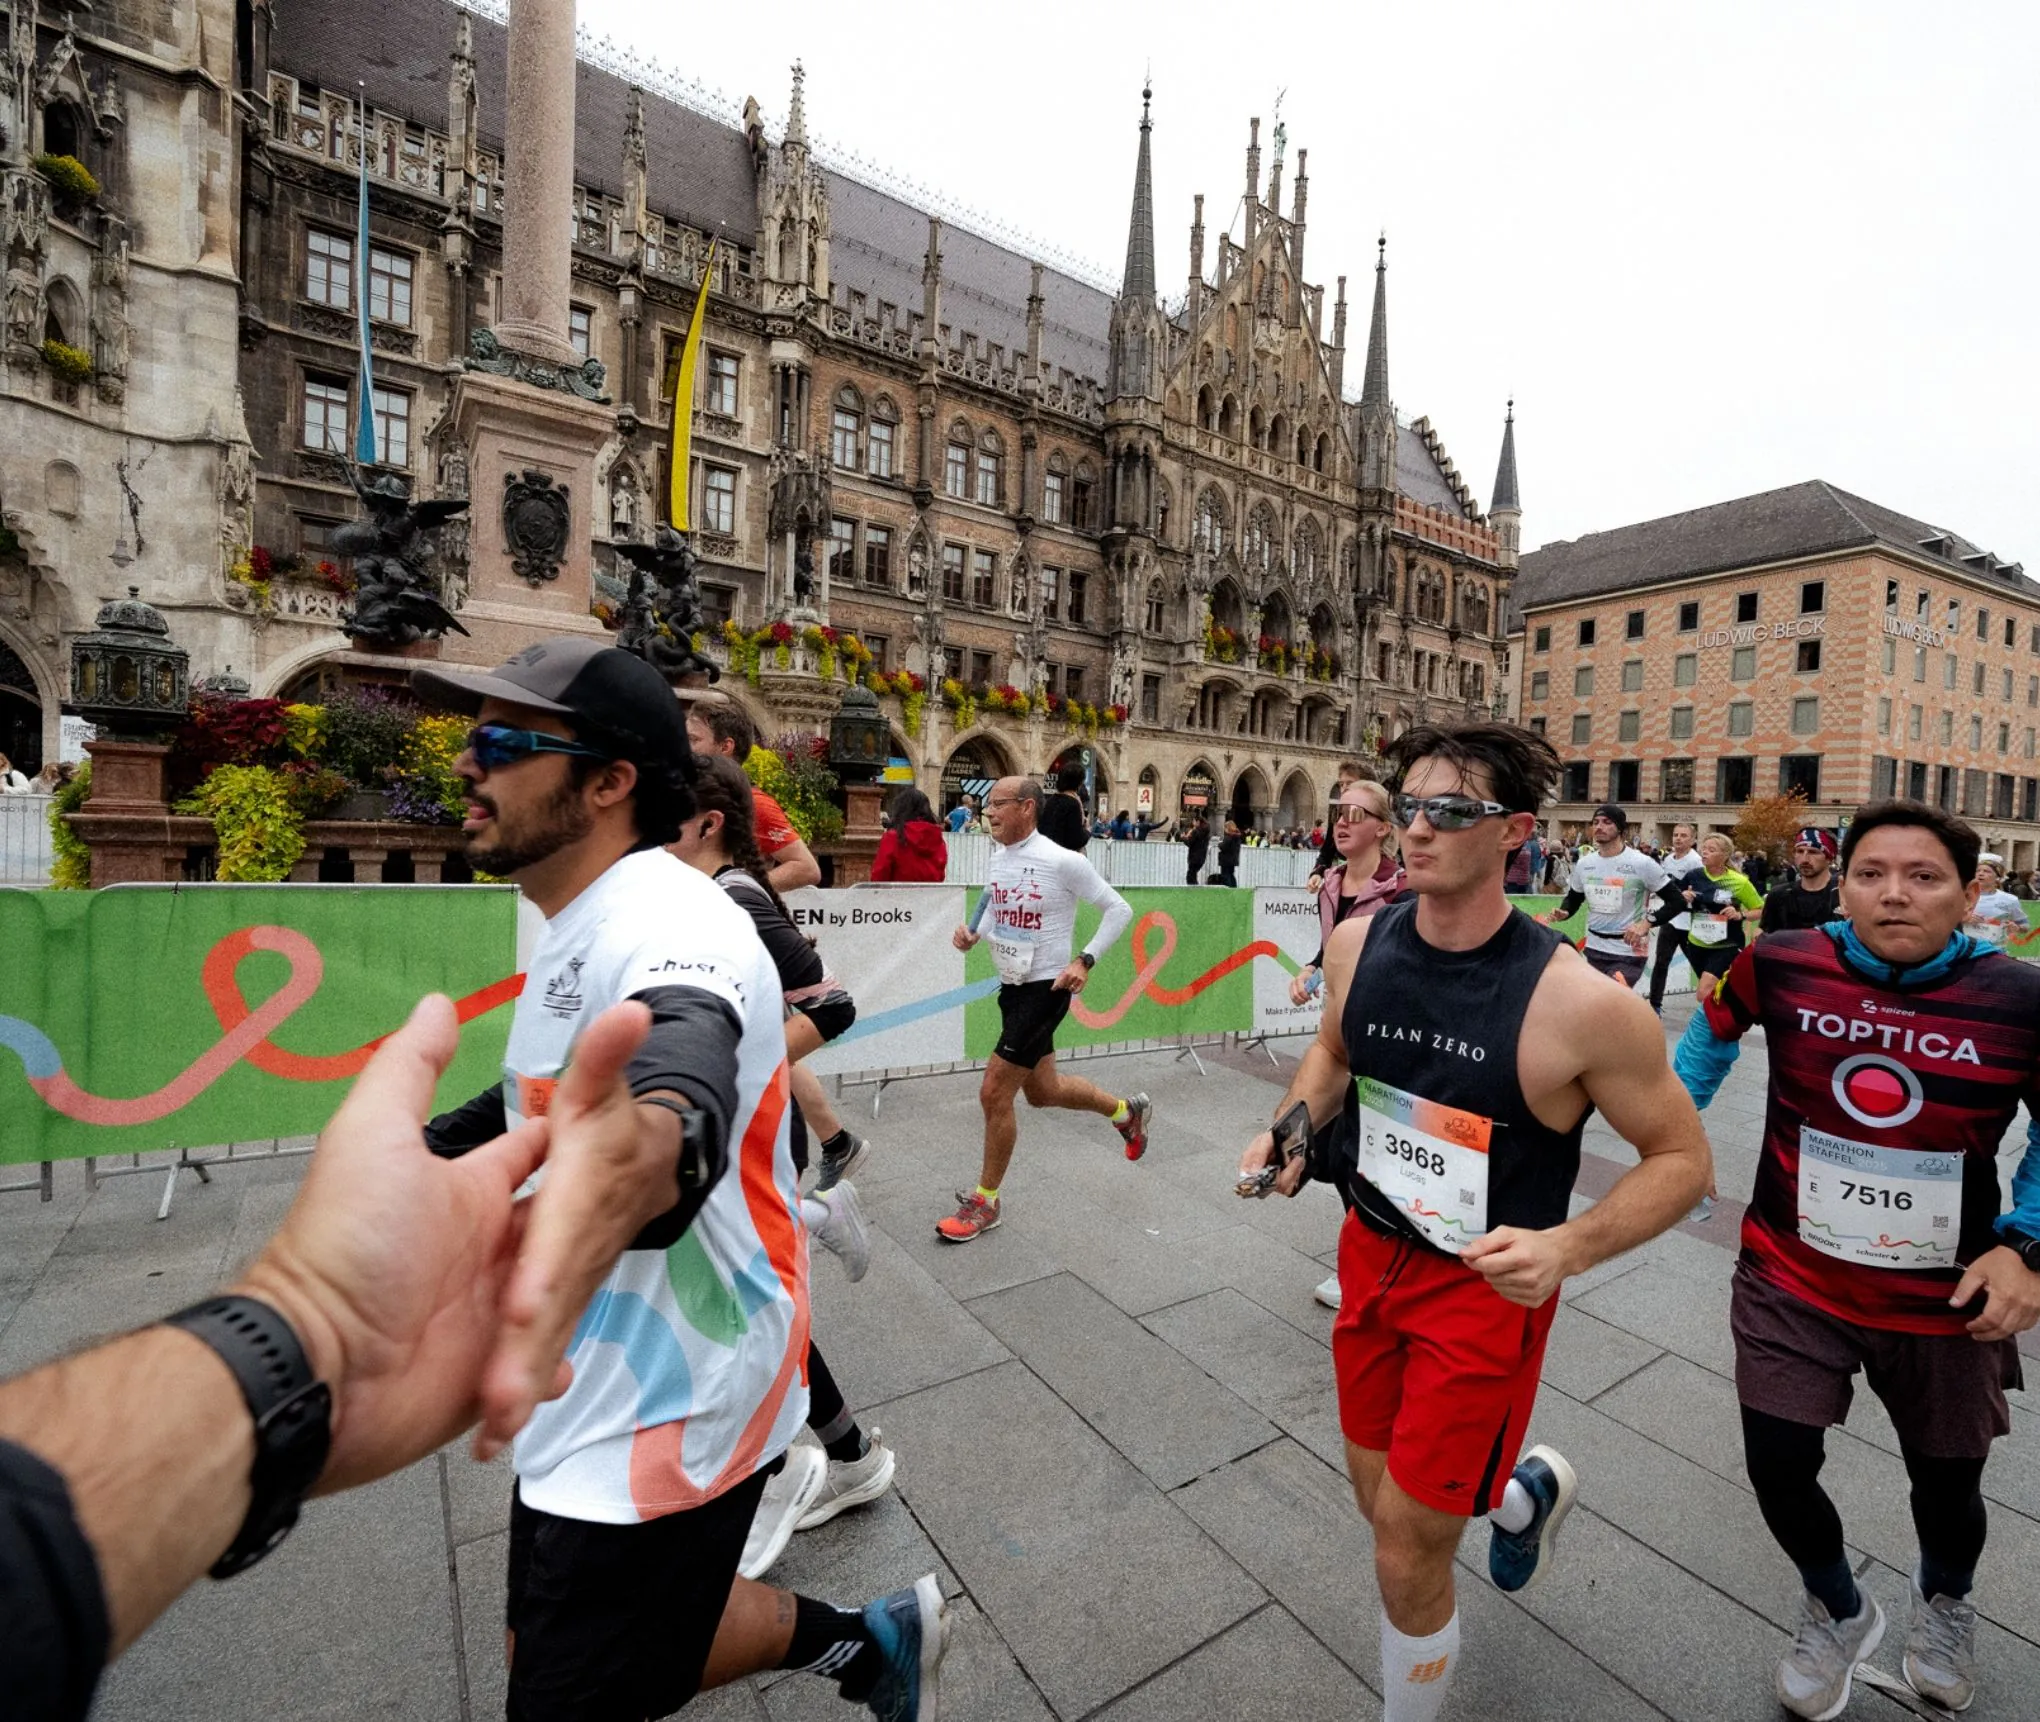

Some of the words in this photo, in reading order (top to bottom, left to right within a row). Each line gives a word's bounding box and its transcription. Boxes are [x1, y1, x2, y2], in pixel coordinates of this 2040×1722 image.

[1696, 624, 1769, 649] LUDWIG
[1773, 616, 1826, 640] BECK
[1883, 614, 1921, 642] LUDWIG
[1923, 626, 1945, 649] BECK
[1082, 750, 1090, 766] S
[830, 912, 847, 927] by
[852, 907, 912, 924] Brooks
[1265, 902, 1320, 916] MARATHO
[996, 943, 1017, 957] 7342
[1265, 1007, 1283, 1016] Make
[1880, 1005, 1916, 1018] spized
[1366, 1023, 1423, 1044] PLAN
[1432, 1033, 1486, 1062] ZERO
[1796, 1007, 1982, 1066] TOPTICA
[1363, 1082, 1414, 1111] MARATHON
[1366, 1134, 1375, 1147] C
[1808, 1133, 1875, 1159] MARATHON
[1384, 1132, 1446, 1178] 3968
[1808, 1143, 1855, 1166] STAFFEL
[1857, 1156, 1889, 1172] 2025
[1399, 1165, 1427, 1186] Lucas
[1809, 1181, 1818, 1194] E
[1838, 1179, 1914, 1211] 7516
[1806, 1231, 1843, 1251] BROOKS
[1855, 1248, 1890, 1260] schuster
